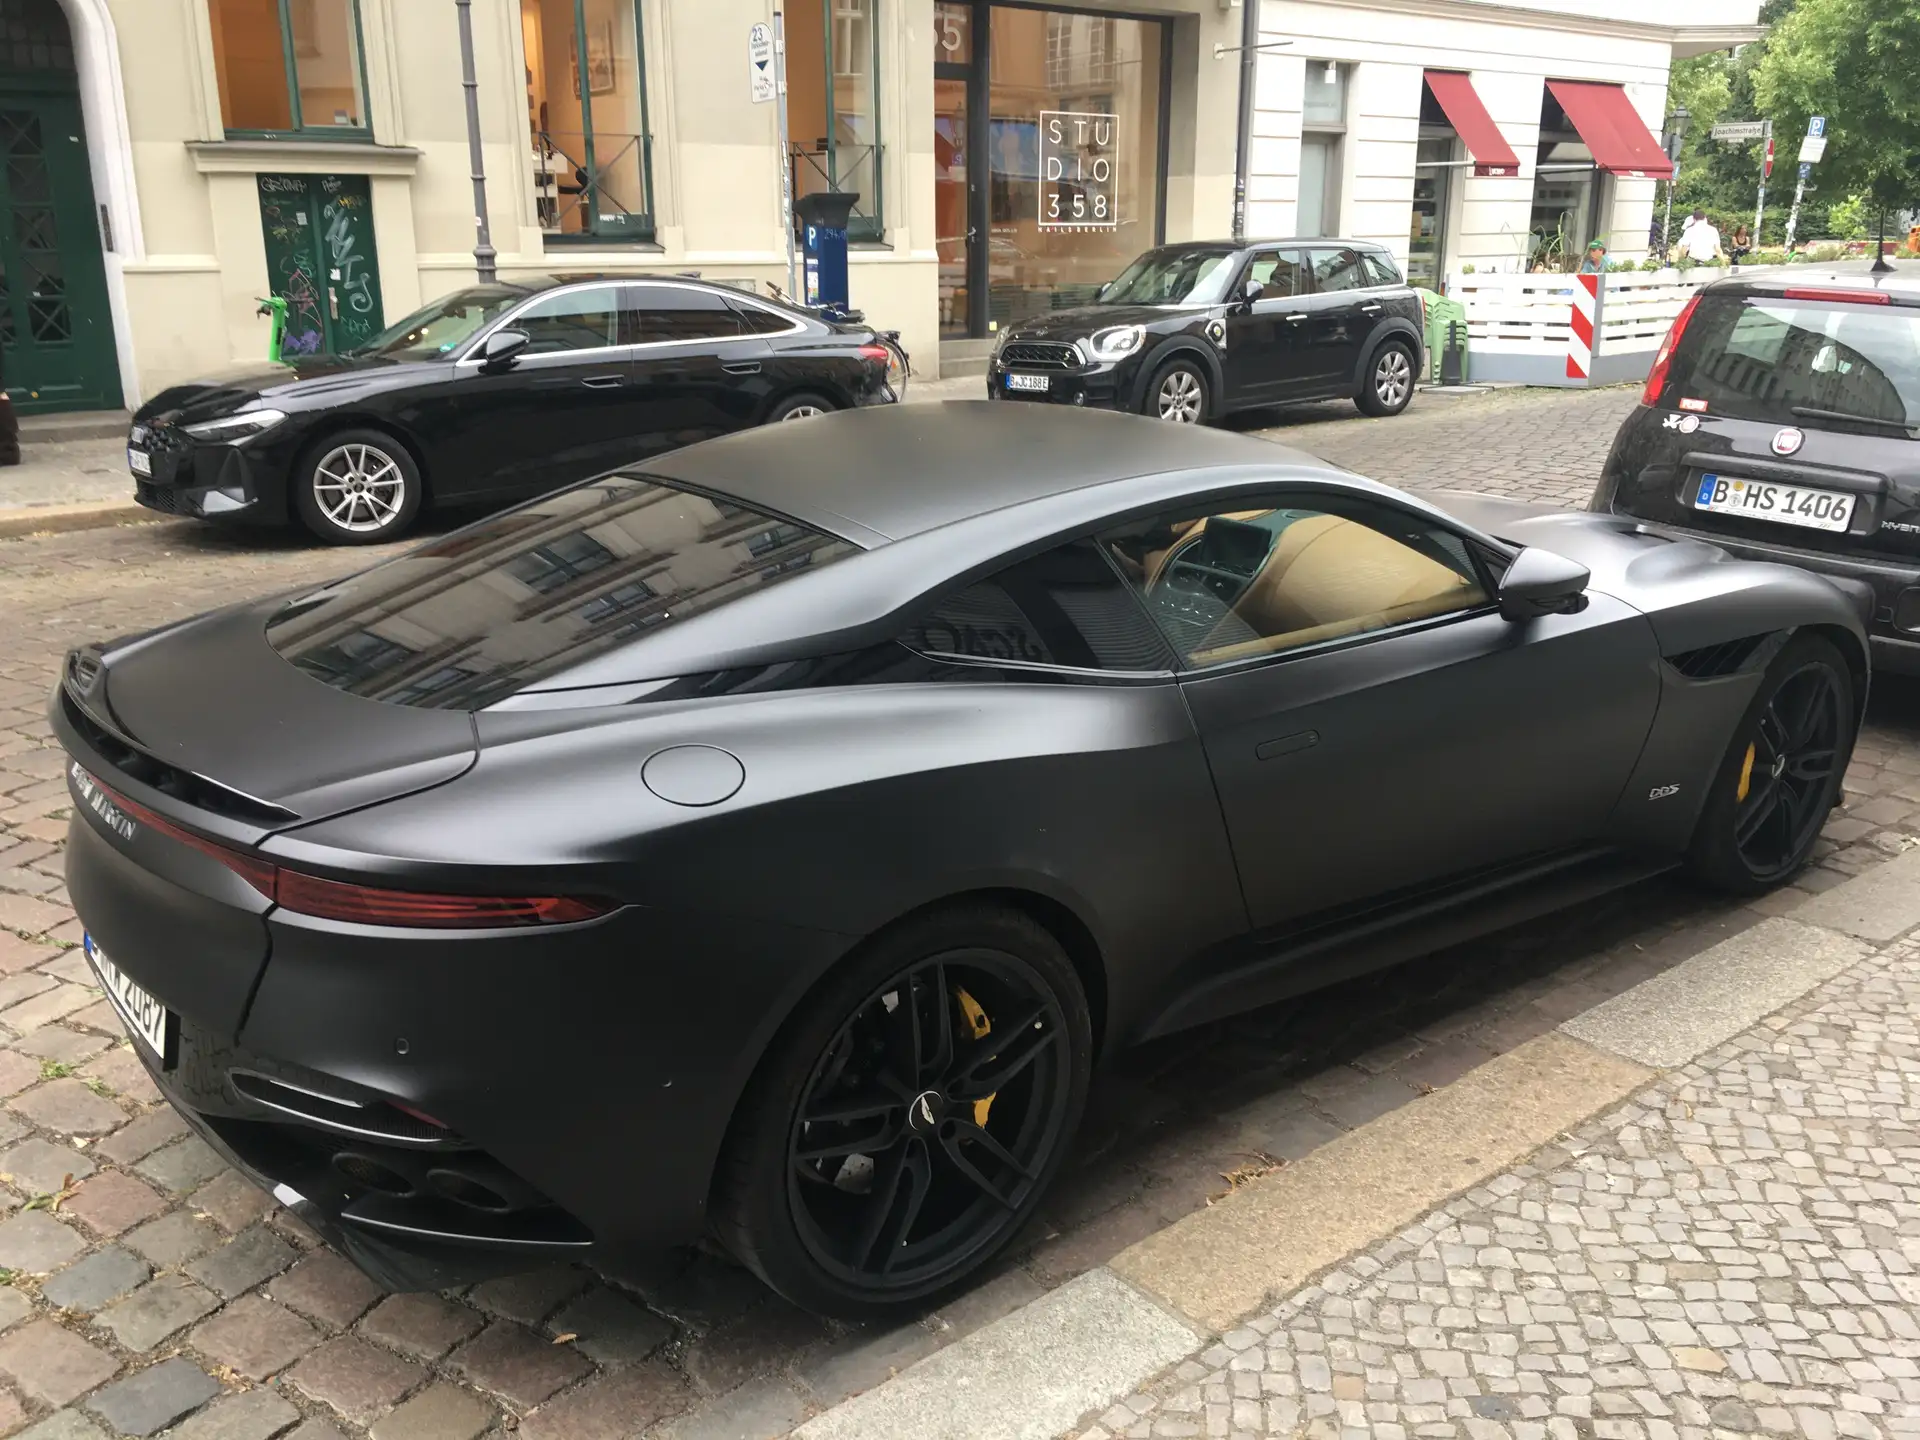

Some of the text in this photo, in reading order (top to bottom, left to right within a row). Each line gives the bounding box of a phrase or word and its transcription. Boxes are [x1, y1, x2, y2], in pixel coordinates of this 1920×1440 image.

[751, 27, 763, 42] 23
[1048, 119, 1110, 146] STU
[1714, 126, 1761, 137] Joachimstraße
[1047, 156, 1110, 182] DIO
[1047, 193, 1107, 218] 358
[808, 226, 817, 247] P
[1712, 480, 1730, 504] B
[1742, 484, 1778, 510] HS
[1780, 490, 1847, 522] 1406
